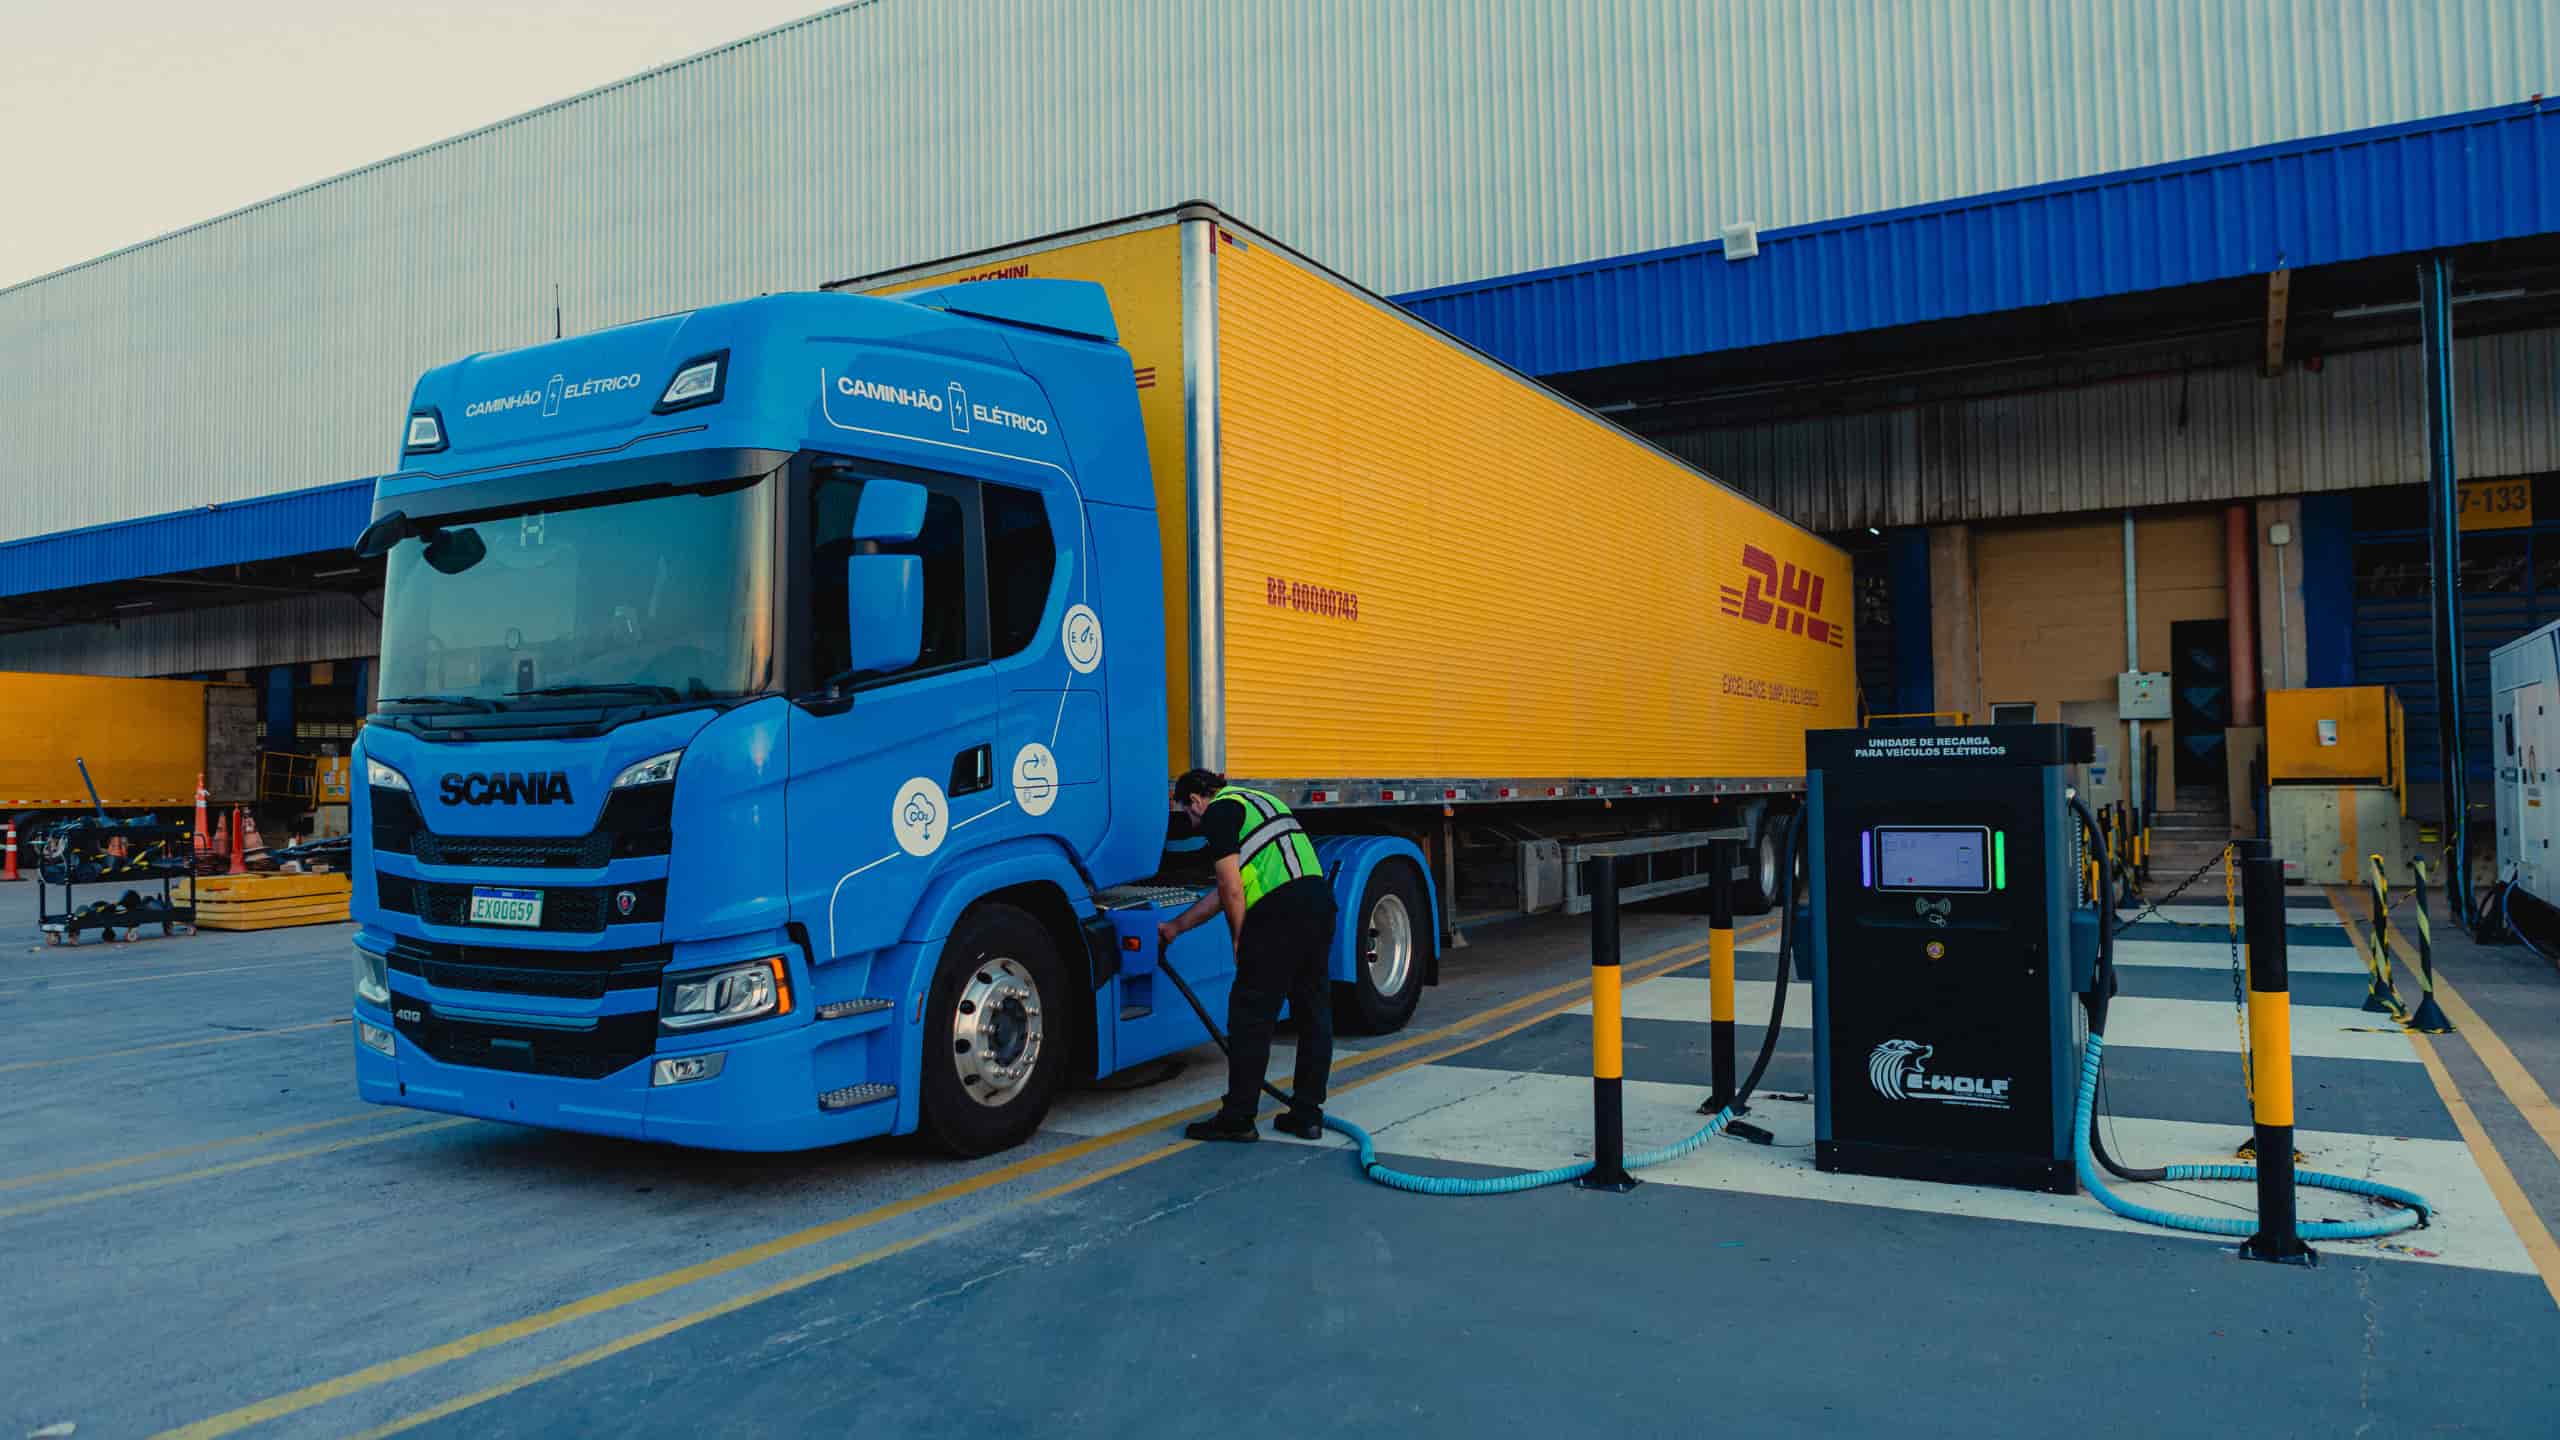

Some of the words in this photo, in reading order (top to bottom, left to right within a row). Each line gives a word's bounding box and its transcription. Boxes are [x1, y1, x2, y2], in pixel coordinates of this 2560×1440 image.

[959, 263, 1029, 284] CCHINI
[465, 390, 542, 417] CAMINHÃO
[563, 373, 641, 399] ELÉTRICO
[837, 376, 943, 413] CAMINHÃO
[972, 402, 1049, 436] ELÉTRICO
[1266, 575, 1359, 622] BR-00000743
[1741, 543, 1830, 645] DHL
[1855, 749, 1884, 758] PARA
[1868, 738, 1917, 748] UNIDADE
[1919, 738, 1935, 747] DE
[1937, 736, 1990, 746] RECARGA
[440, 771, 575, 806] SCANIA
[1906, 1073, 2009, 1095] E-WOLF
